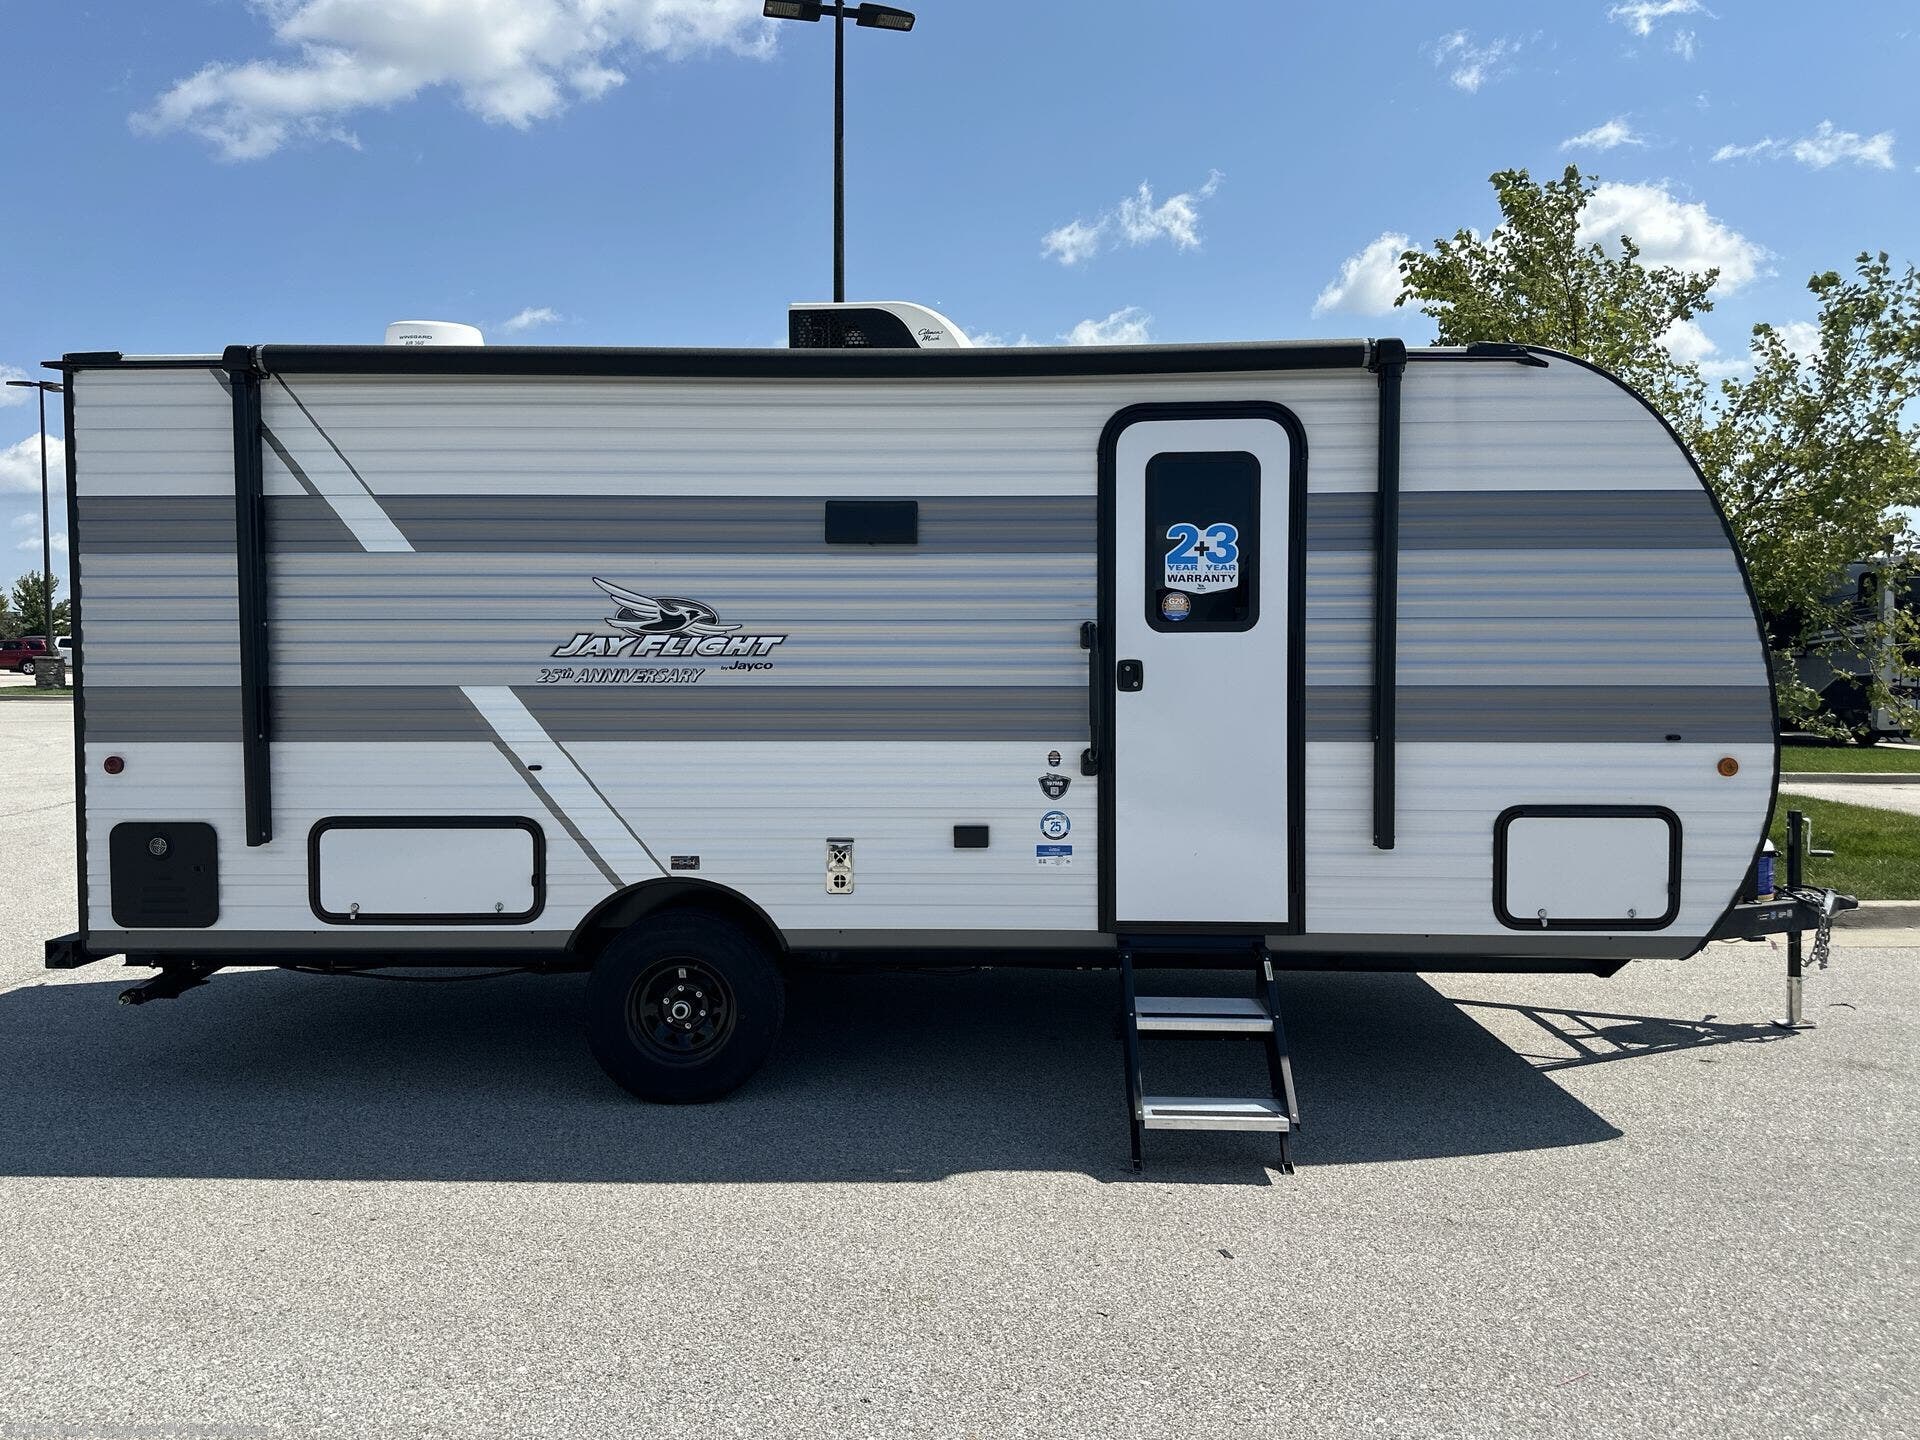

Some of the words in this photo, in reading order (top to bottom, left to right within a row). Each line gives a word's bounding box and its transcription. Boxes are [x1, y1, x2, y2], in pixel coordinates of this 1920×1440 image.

[1167, 574, 1236, 583] WARRANTY
[550, 633, 636, 657] JAY
[630, 634, 788, 657] FLIGHT
[728, 661, 774, 671] Jayco
[536, 667, 574, 684] 25th
[574, 668, 706, 684] ANNIVERSARY
[1050, 821, 1062, 832] 25
